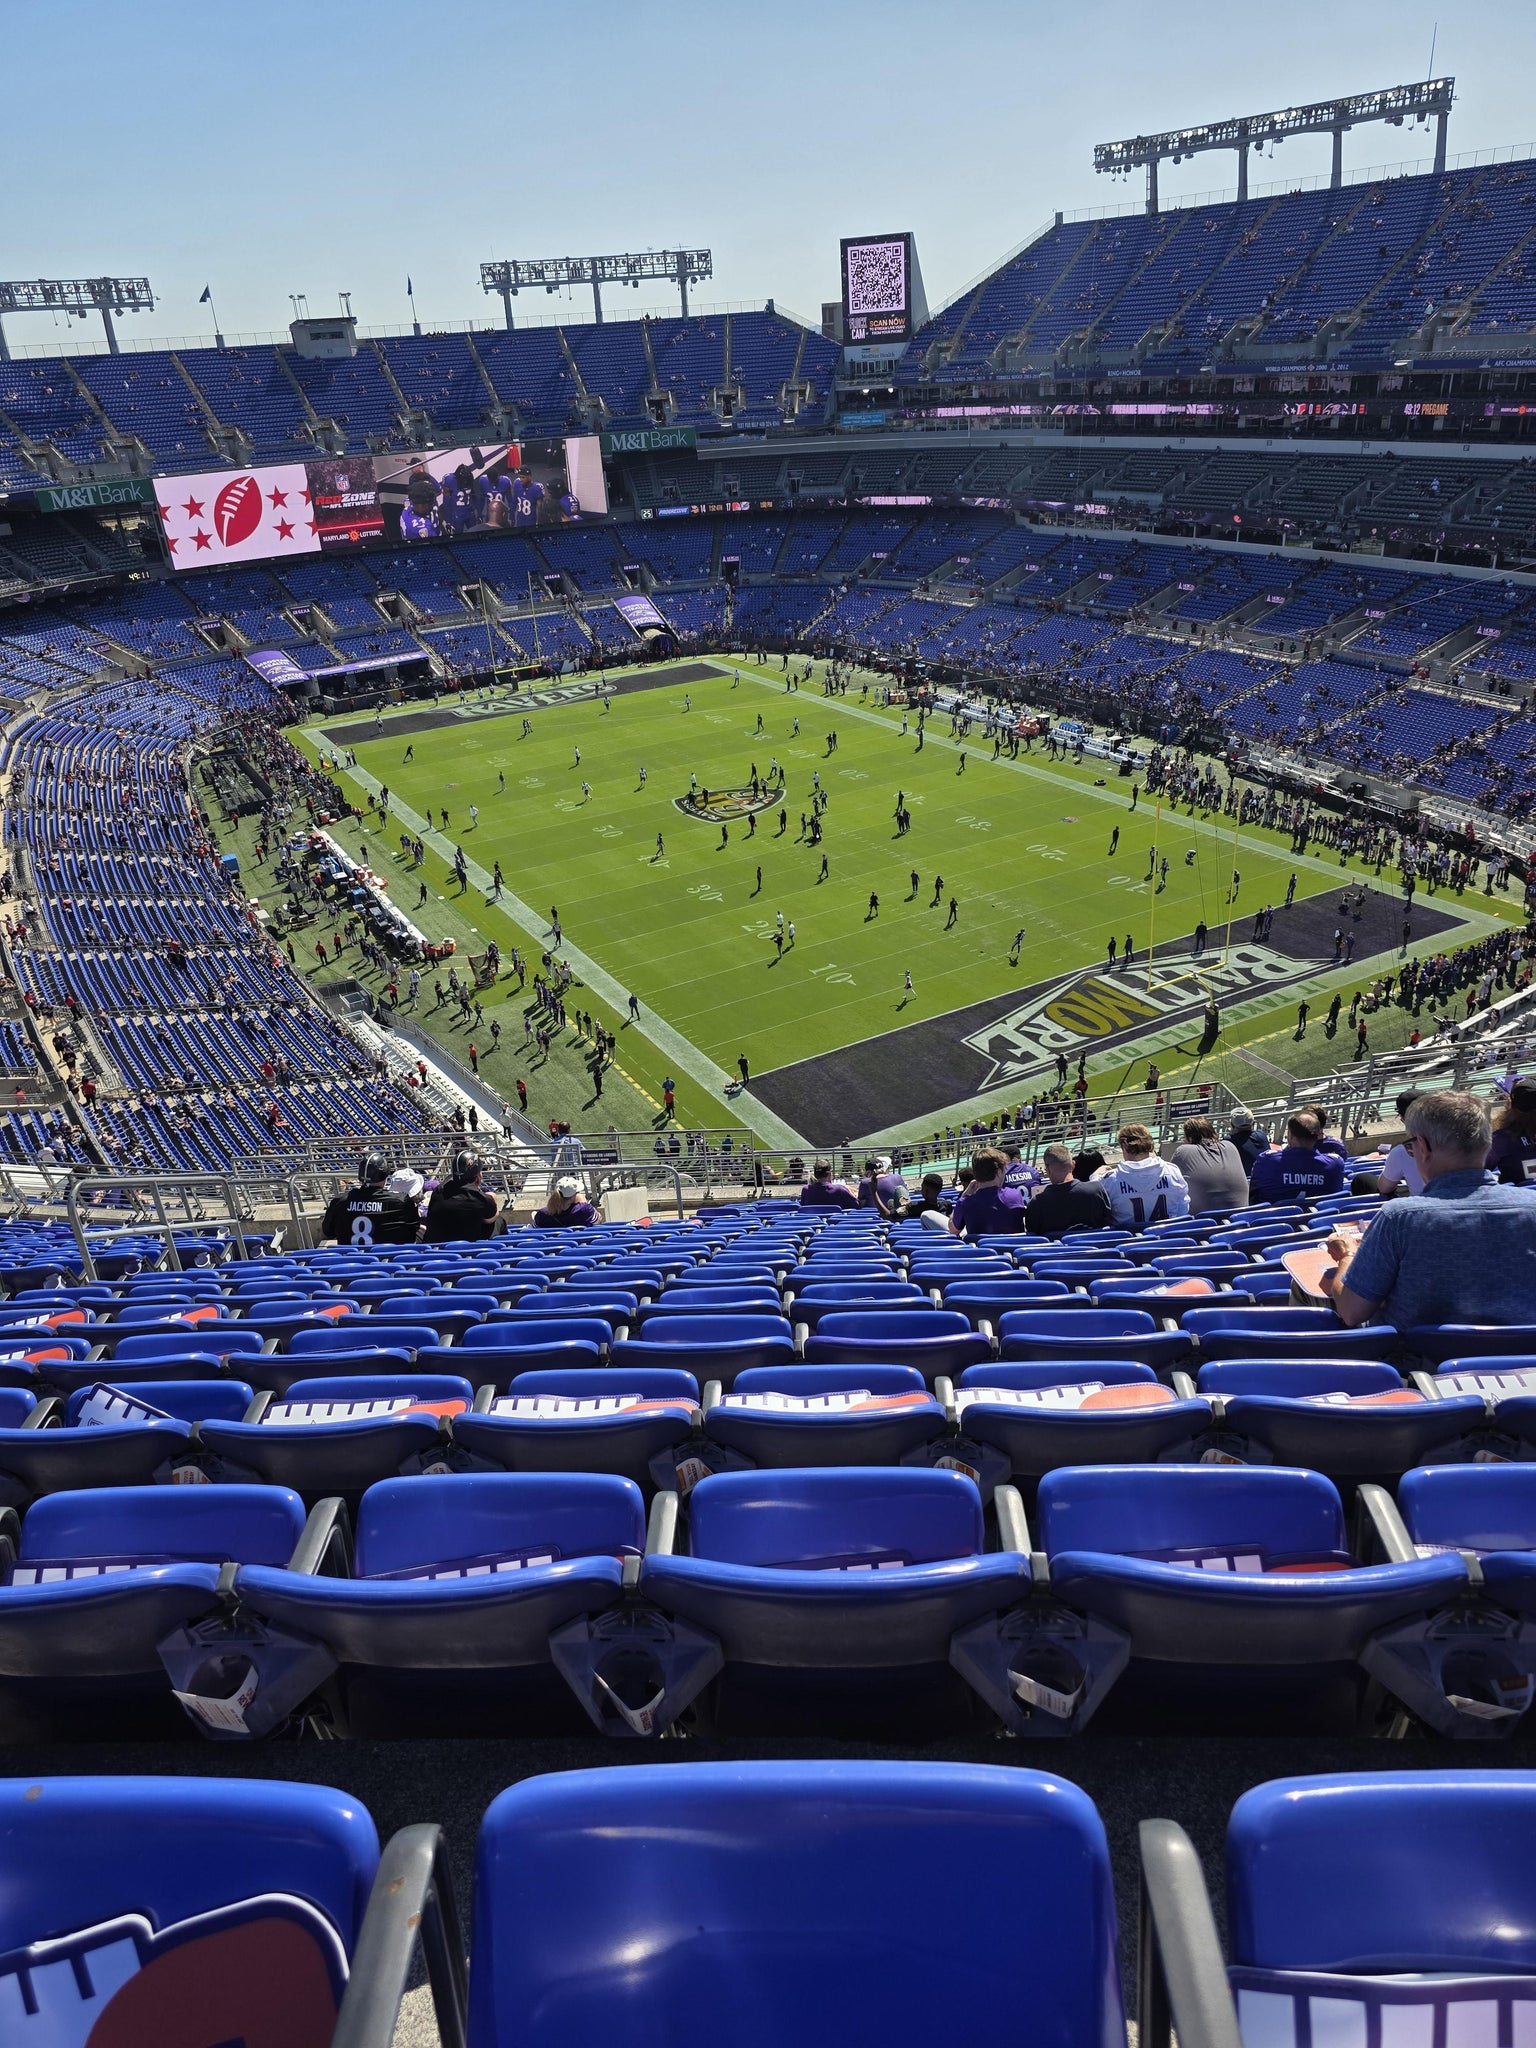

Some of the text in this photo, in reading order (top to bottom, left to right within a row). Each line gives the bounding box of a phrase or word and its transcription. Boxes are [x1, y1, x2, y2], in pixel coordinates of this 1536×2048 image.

[889, 317, 905, 326] NOW
[852, 328, 866, 340] CAM
[1421, 403, 1449, 415] PREGAME
[610, 429, 687, 451] M&T Bank
[48, 481, 144, 510] M&T Bank
[343, 500, 375, 508] NETWORK
[323, 533, 349, 542] MARYLAND
[452, 683, 616, 718] RAVENS
[808, 963, 854, 984] 10
[1299, 980, 1329, 996] IT
[961, 942, 1333, 1091] BALTIMORE
[1219, 992, 1297, 1024] TAKES
[1162, 1023, 1201, 1045] ALL
[1105, 1046, 1143, 1064] OF
[1005, 1172, 1033, 1184] JACKSON
[1283, 1173, 1325, 1186] FLOWERS
[347, 1201, 383, 1212] JACKSON
[1129, 1194, 1170, 1223] 14
[351, 1216, 373, 1246] 8
